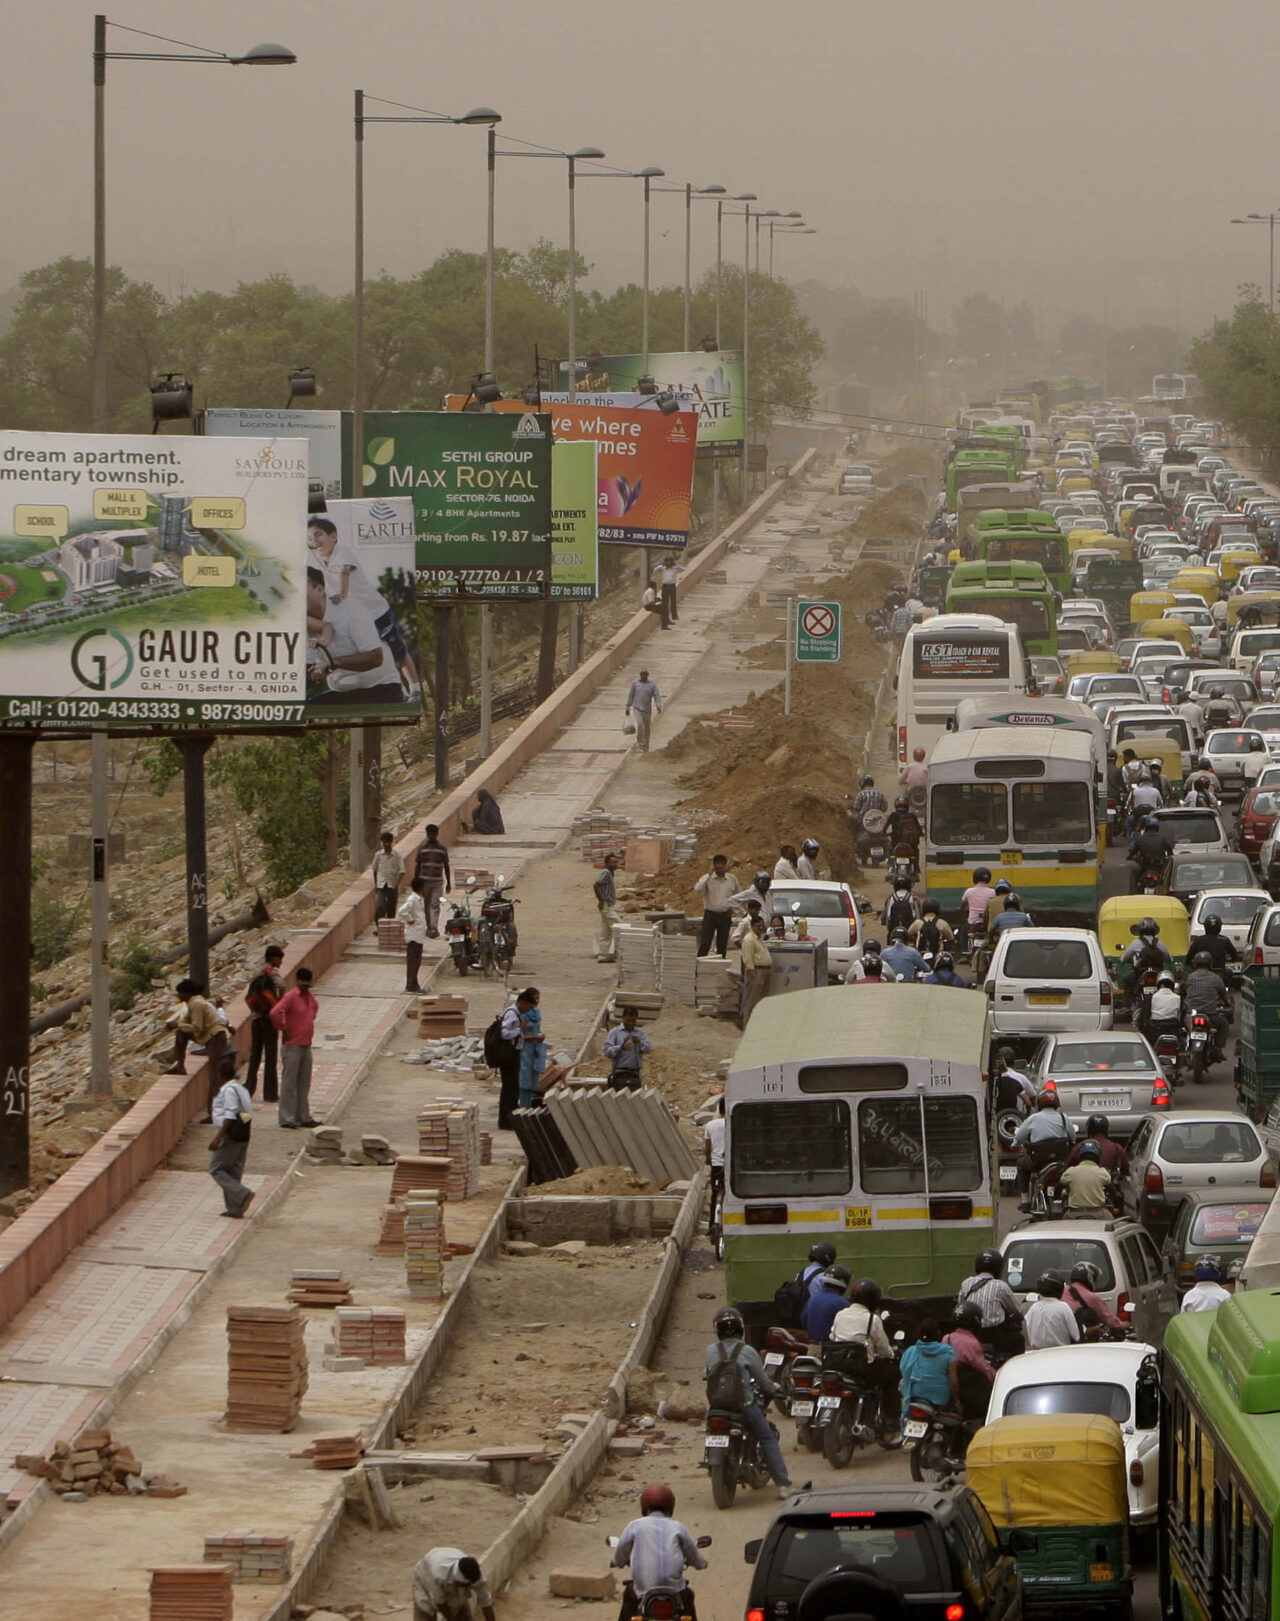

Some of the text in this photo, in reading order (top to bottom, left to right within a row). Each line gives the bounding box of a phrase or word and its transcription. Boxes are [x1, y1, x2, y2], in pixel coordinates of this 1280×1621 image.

[287, 421, 336, 430] AFFORDABILITY
[580, 417, 641, 437] where
[4, 447, 181, 466] dream apartment.
[442, 452, 533, 463] SETHI GROUP
[234, 459, 306, 471] SAVIOUR
[0, 467, 185, 487] mentary township.
[389, 465, 539, 488] MAX ROYAL
[107, 493, 127, 502] MALL
[505, 494, 536, 504] NOIDA
[102, 507, 142, 517] MULTIPLEX
[203, 509, 234, 519] OFFICES
[435, 509, 443, 518] 4
[445, 509, 465, 518] BHK
[467, 509, 521, 520] Apartments
[26, 516, 57, 527] SCHOOL
[357, 522, 414, 538] EARTH
[444, 532, 469, 543] from
[471, 533, 488, 543] Rs.
[491, 530, 529, 544] 19.87
[197, 565, 221, 577] HOTEL
[415, 569, 500, 582] 99102-77770
[515, 570, 522, 582] 1
[536, 569, 545, 582] 2
[563, 586, 571, 595] to
[139, 628, 300, 665] GAUR CITY
[922, 643, 953, 657] RST
[140, 666, 299, 681] Get used to more
[141, 682, 165, 691] G.H.
[177, 682, 195, 693] 01,
[197, 684, 235, 693] Sector
[247, 685, 257, 694] 4,
[261, 684, 298, 694] GNIDA
[9, 700, 42, 717] Call
[57, 701, 181, 719] 0120-4343333
[201, 704, 305, 721] 9873900977
[4, 1066, 29, 1089] AC
[4, 1091, 26, 1115] 21
